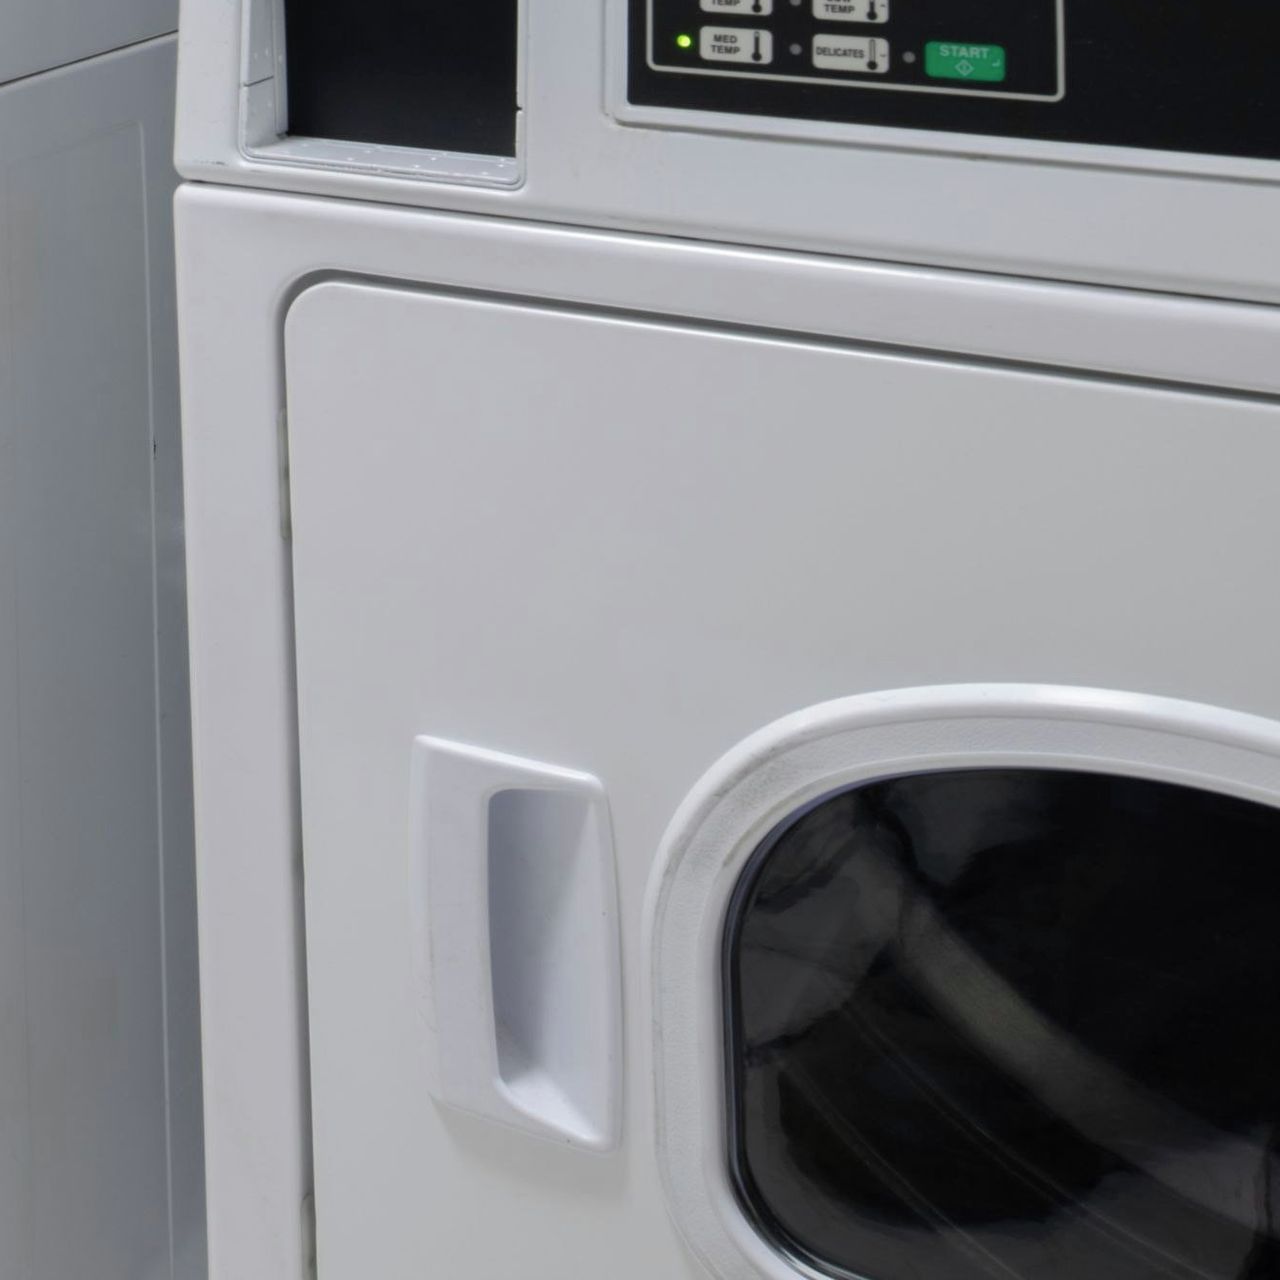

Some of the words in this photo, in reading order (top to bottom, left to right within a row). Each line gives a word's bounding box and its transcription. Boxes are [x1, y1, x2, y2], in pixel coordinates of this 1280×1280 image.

[824, 4, 855, 15] TEMP
[713, 34, 738, 45] MED
[711, 45, 740, 55] TEMP
[815, 46, 865, 59] DELICATES
[939, 44, 991, 59] START
